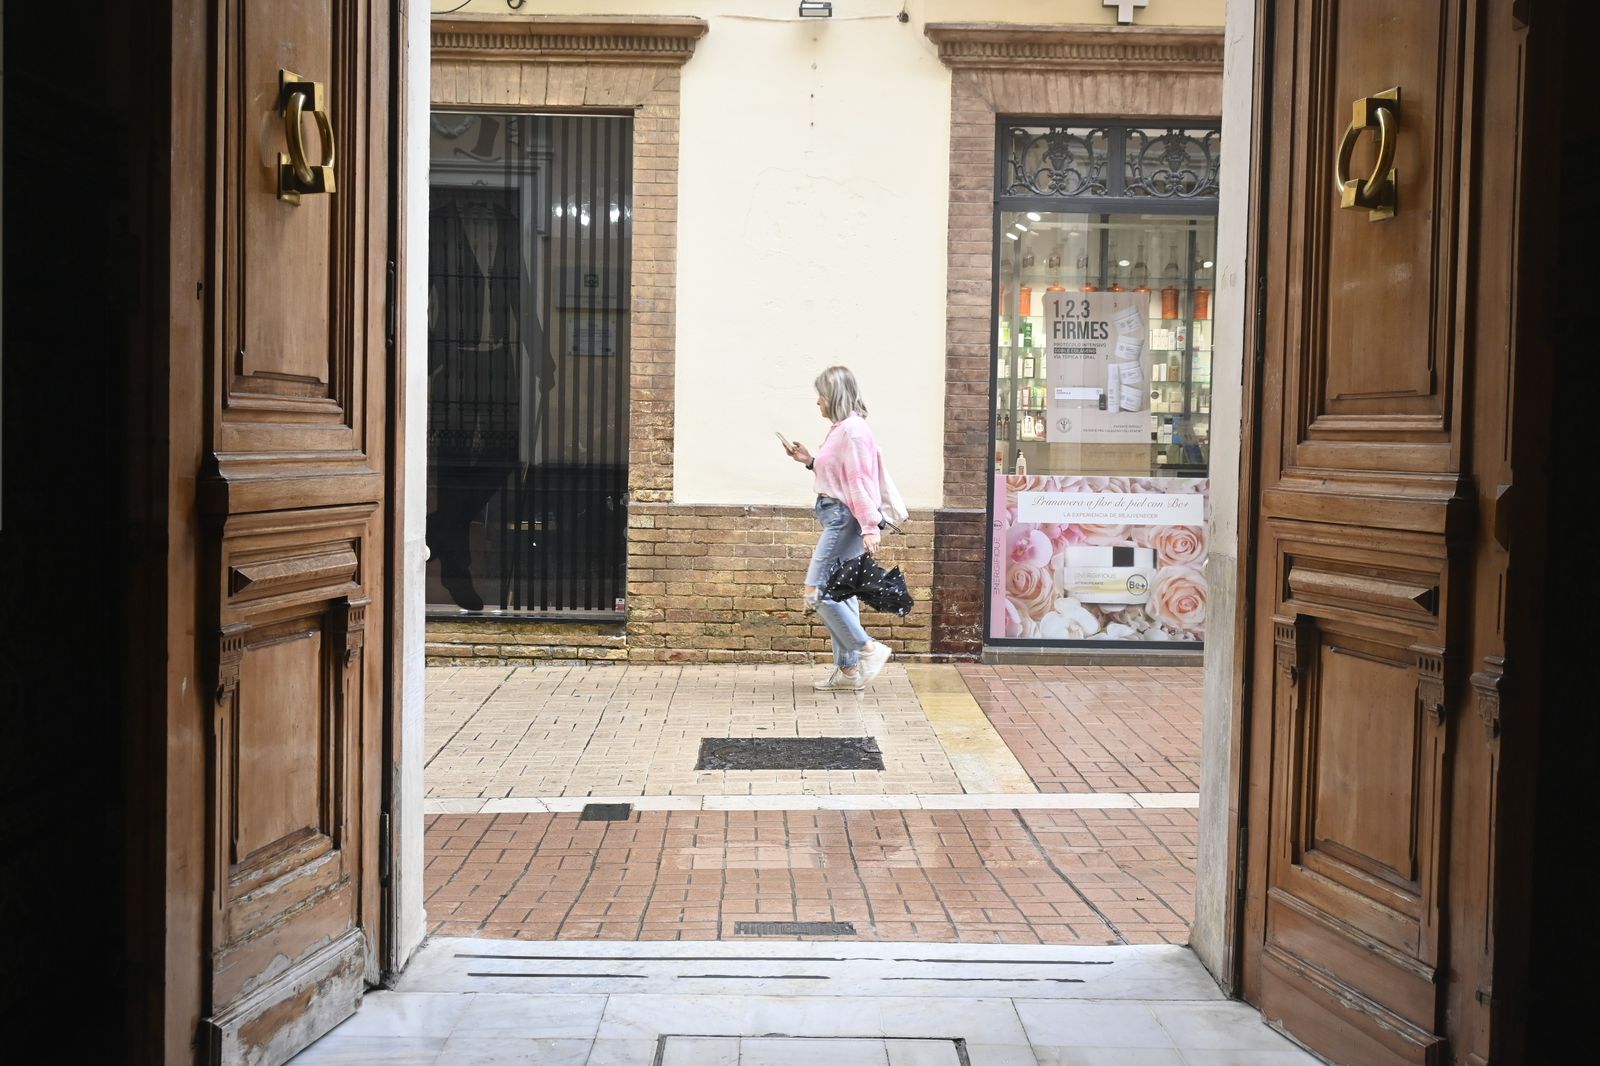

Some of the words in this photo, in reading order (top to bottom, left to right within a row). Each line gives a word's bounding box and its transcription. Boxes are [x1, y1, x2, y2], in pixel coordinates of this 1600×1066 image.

[1053, 300, 1090, 320] 1,2,3
[1053, 321, 1109, 340] FIRMES
[1032, 496, 1083, 506] Primavera
[1090, 496, 1112, 510] flor
[1114, 497, 1125, 508] de
[1125, 497, 1147, 511] piel
[993, 537, 1001, 595] ENERGIFIQUE
[1129, 580, 1146, 590] Be+
